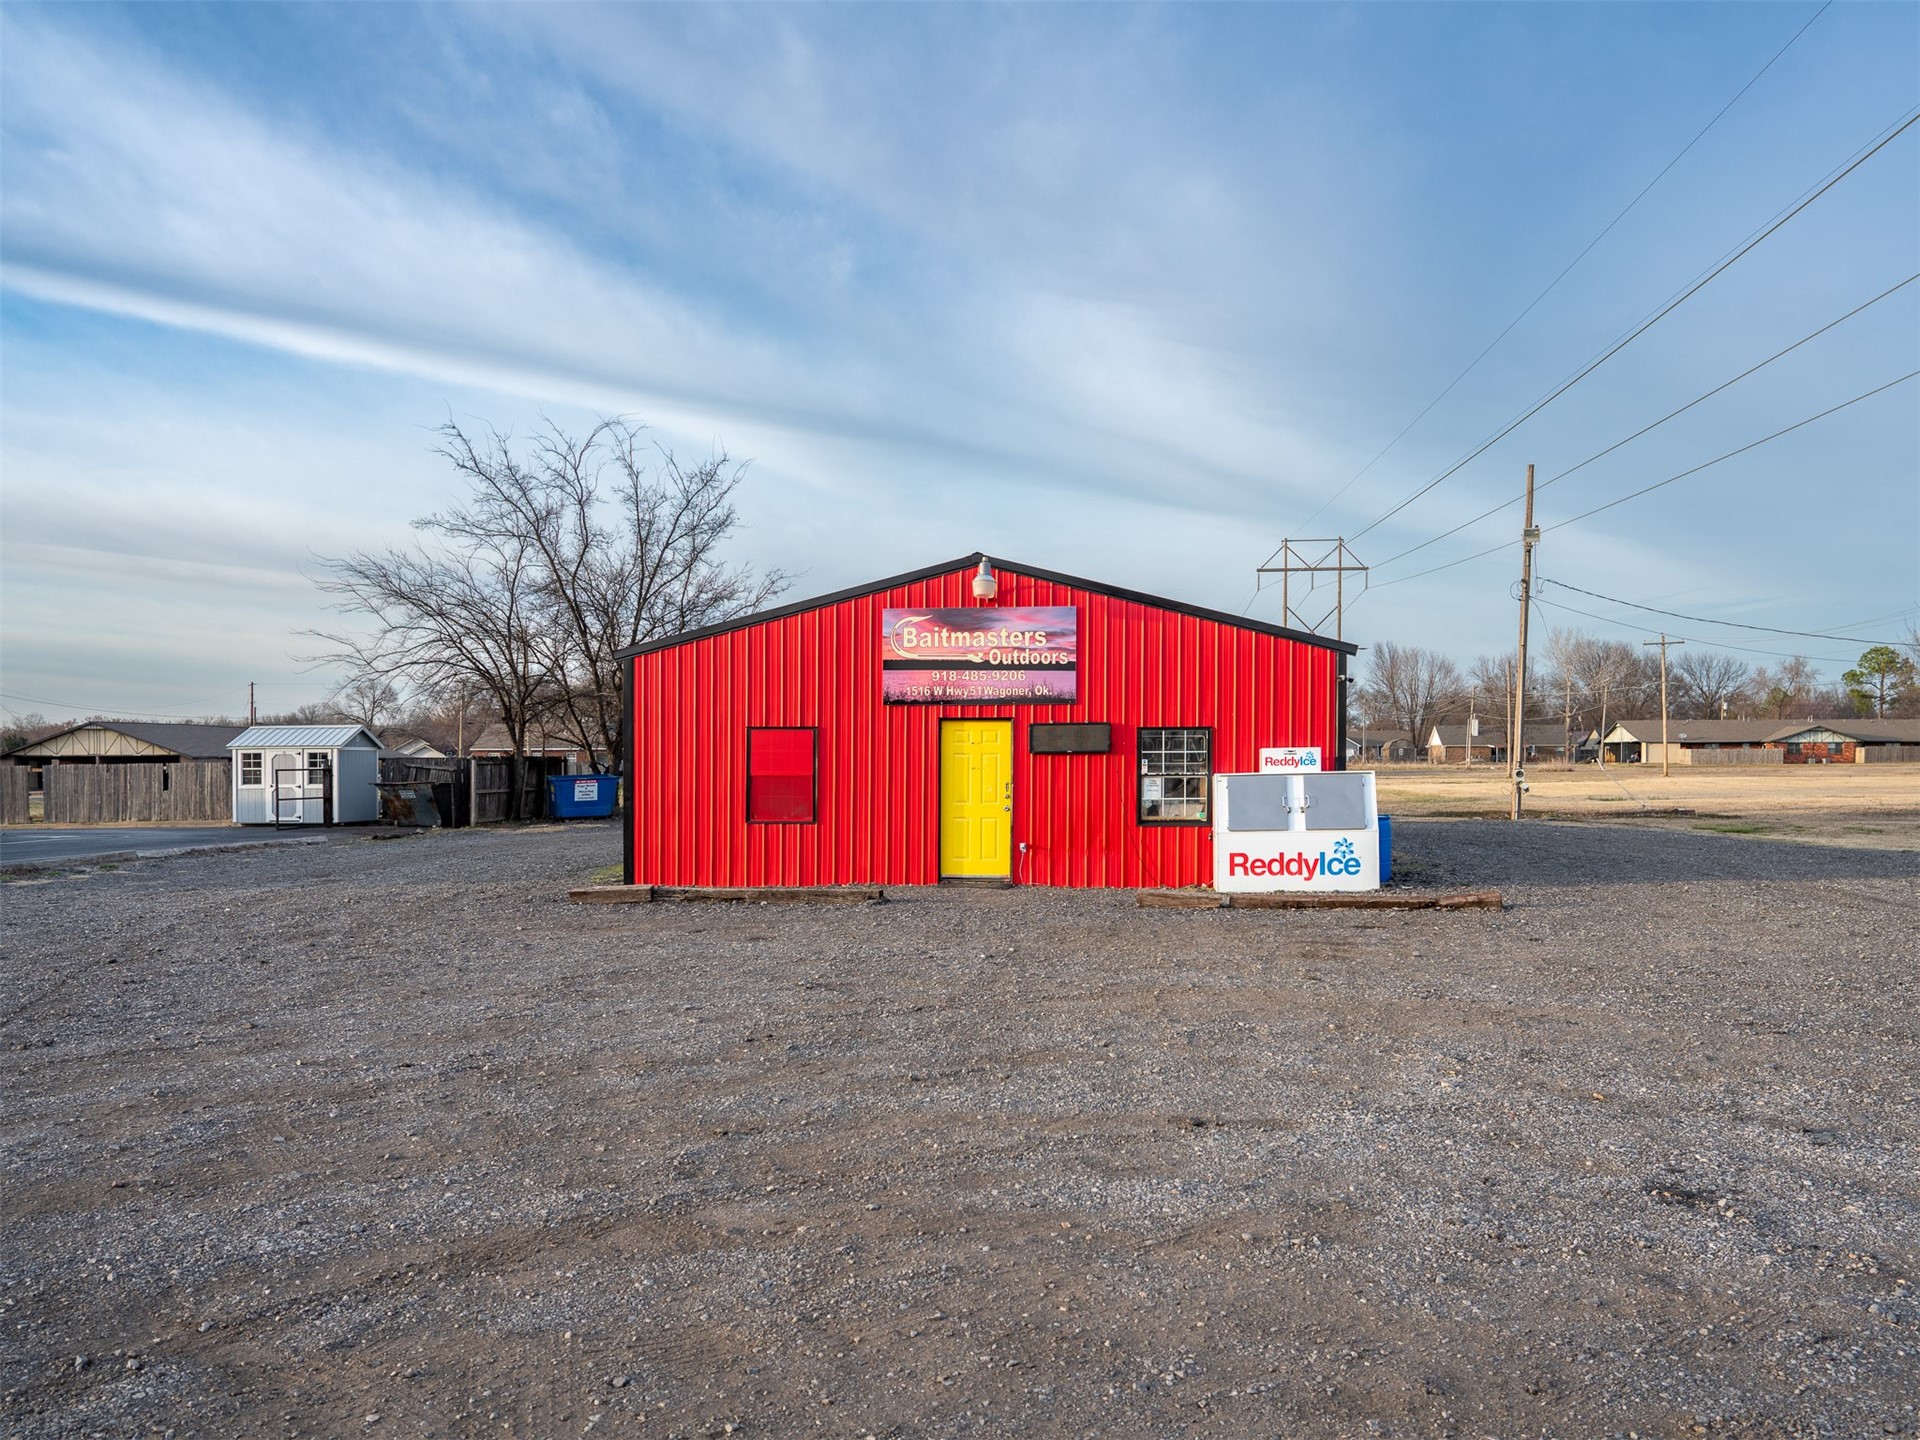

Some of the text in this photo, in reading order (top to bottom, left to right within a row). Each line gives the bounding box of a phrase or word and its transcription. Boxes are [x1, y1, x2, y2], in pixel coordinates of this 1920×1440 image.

[902, 626, 1047, 648] Baitmasters
[988, 649, 1069, 665] Outdoors
[931, 670, 1026, 682] 918-485-9206
[905, 685, 1053, 698] 1516 W Hwy 51 Wagoner, Ok.
